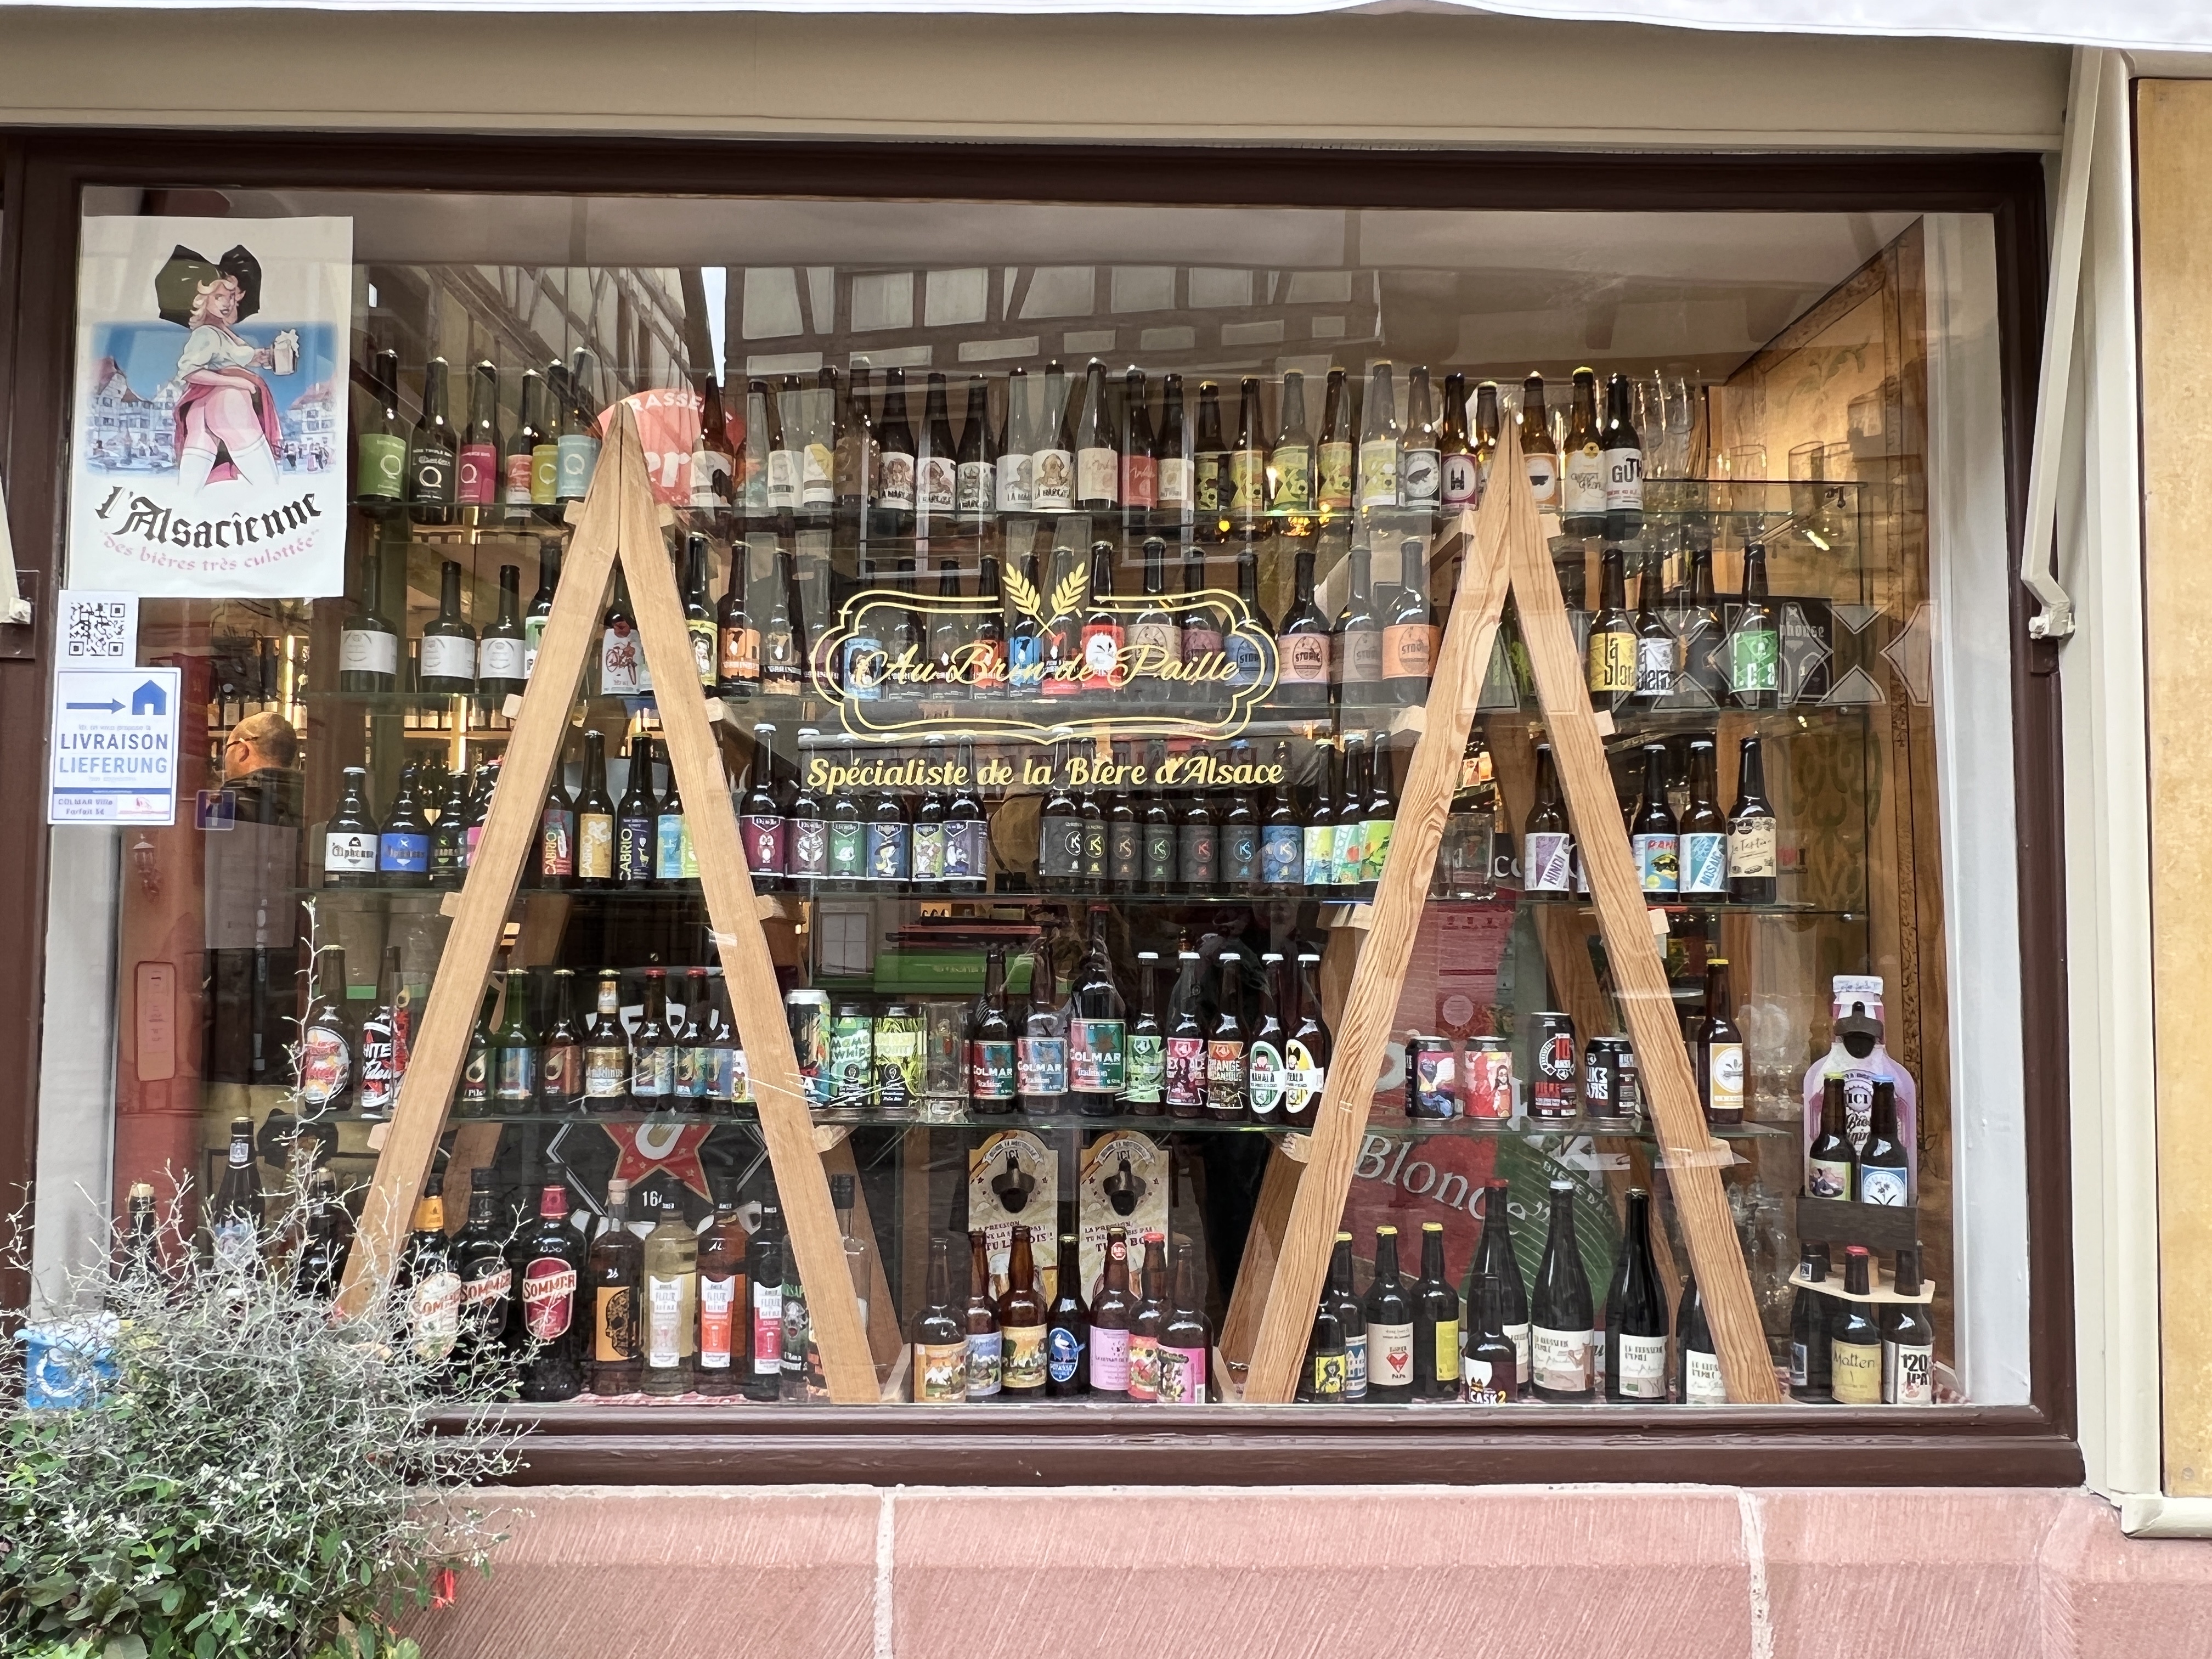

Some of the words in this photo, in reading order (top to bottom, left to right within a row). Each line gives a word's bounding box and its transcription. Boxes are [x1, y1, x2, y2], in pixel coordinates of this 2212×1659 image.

[461, 463, 477, 483] Q
[564, 454, 585, 475] Q
[419, 466, 442, 488] Q
[202, 557, 237, 572] très
[1054, 653, 1095, 682] de
[1107, 645, 1240, 687] Paille
[61, 733, 168, 750] LIVRAISON
[59, 757, 167, 774] LIEFERUNG
[807, 758, 970, 795] Spécialiste
[977, 759, 1015, 786] de
[1023, 759, 1056, 786] la
[1155, 755, 1285, 785] d'Alsace
[545, 832, 557, 876] CABRIO
[619, 828, 633, 881] CABRIO
[1071, 1051, 1121, 1062] COLMAR
[973, 1064, 1013, 1076] COLMAR
[1018, 1061, 1062, 1072] COLMAR
[1848, 1093, 1868, 1104] ICI
[524, 1275, 575, 1300] SOMMER
[1833, 1352, 1876, 1373] Matten
[1906, 1372, 1928, 1386] IPA
[1470, 1391, 1497, 1404] CASK
[1497, 1390, 1507, 1404] 2
